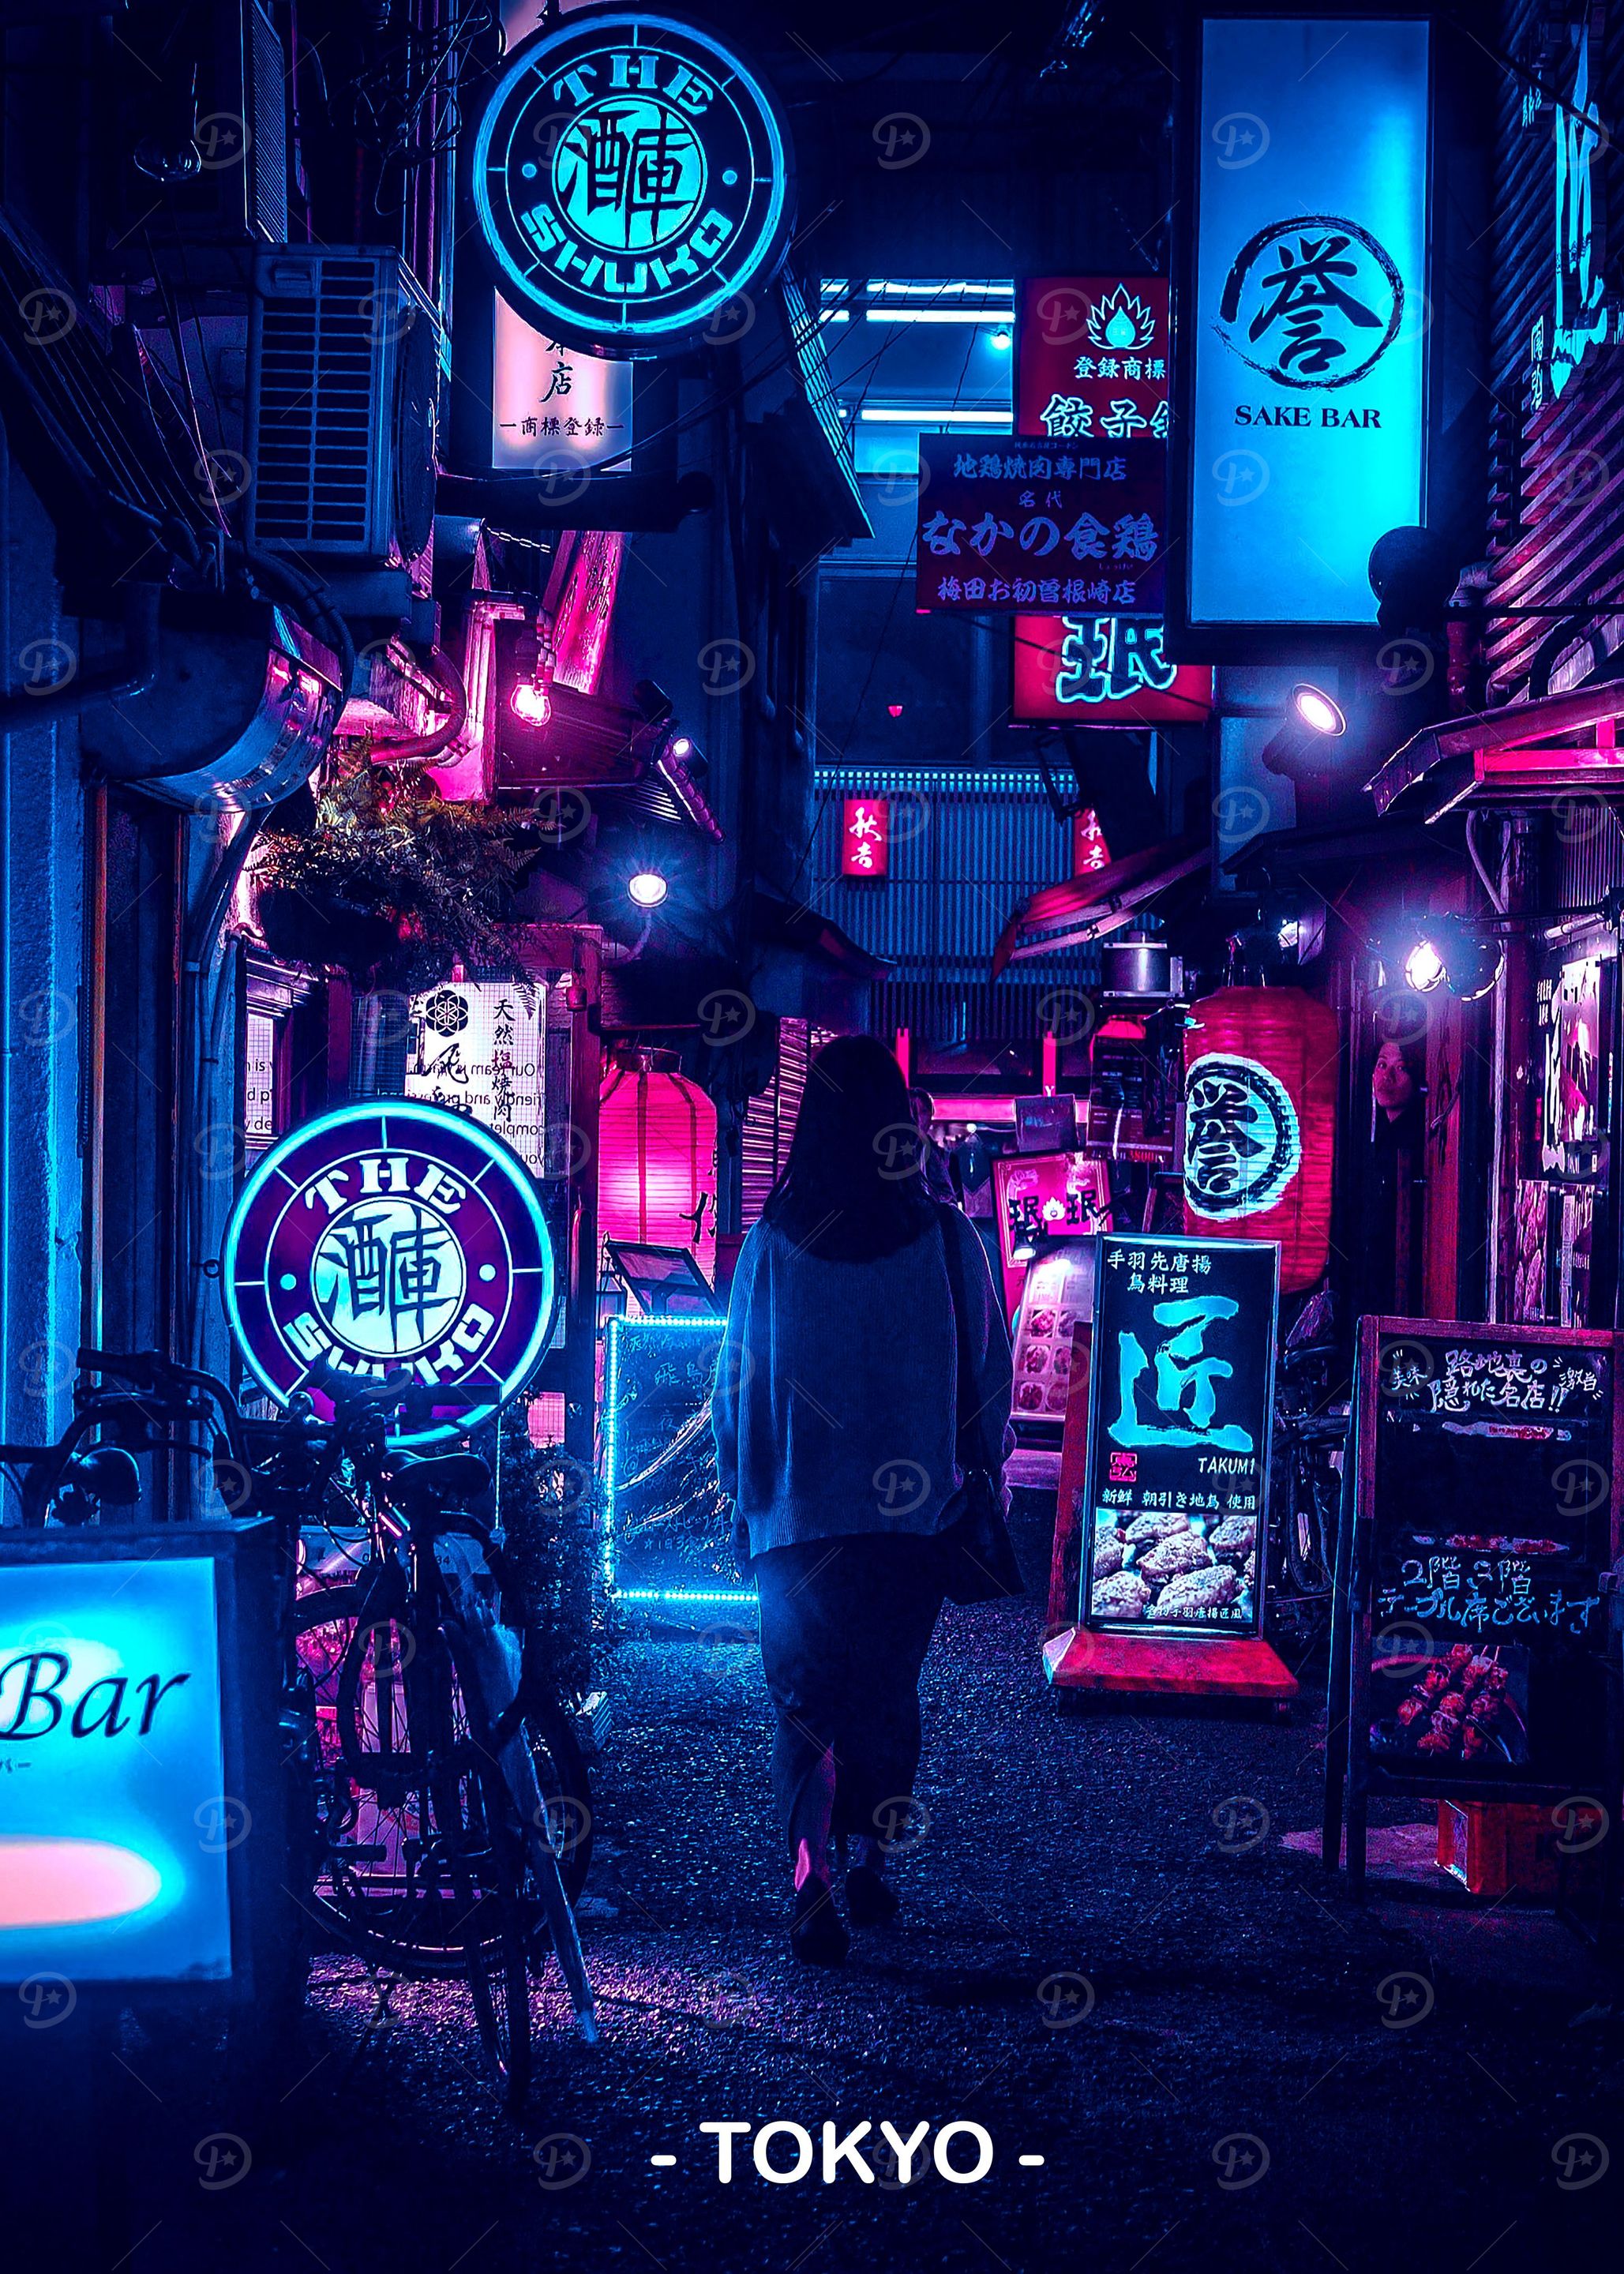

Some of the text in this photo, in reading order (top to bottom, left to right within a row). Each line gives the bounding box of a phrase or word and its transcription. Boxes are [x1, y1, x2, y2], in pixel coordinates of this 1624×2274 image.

[553, 54, 714, 116] THE
[520, 203, 733, 295] SHUKO
[1074, 356, 1166, 381] 登録商標
[1234, 406, 1382, 429] SAKE BAR
[954, 453, 1127, 481] 地鶏焼肉専門店
[922, 510, 1159, 562] なかの食鶏
[305, 1158, 467, 1214] THE
[1107, 1248, 1212, 1275] 手羽先唐揚
[1127, 1272, 1189, 1295] 鳥料理
[1108, 1295, 1254, 1451] 匠
[1446, 1349, 1547, 1383] 路地裏の
[1227, 1494, 1256, 1510] 使用
[0, 1651, 191, 1741] Bar
